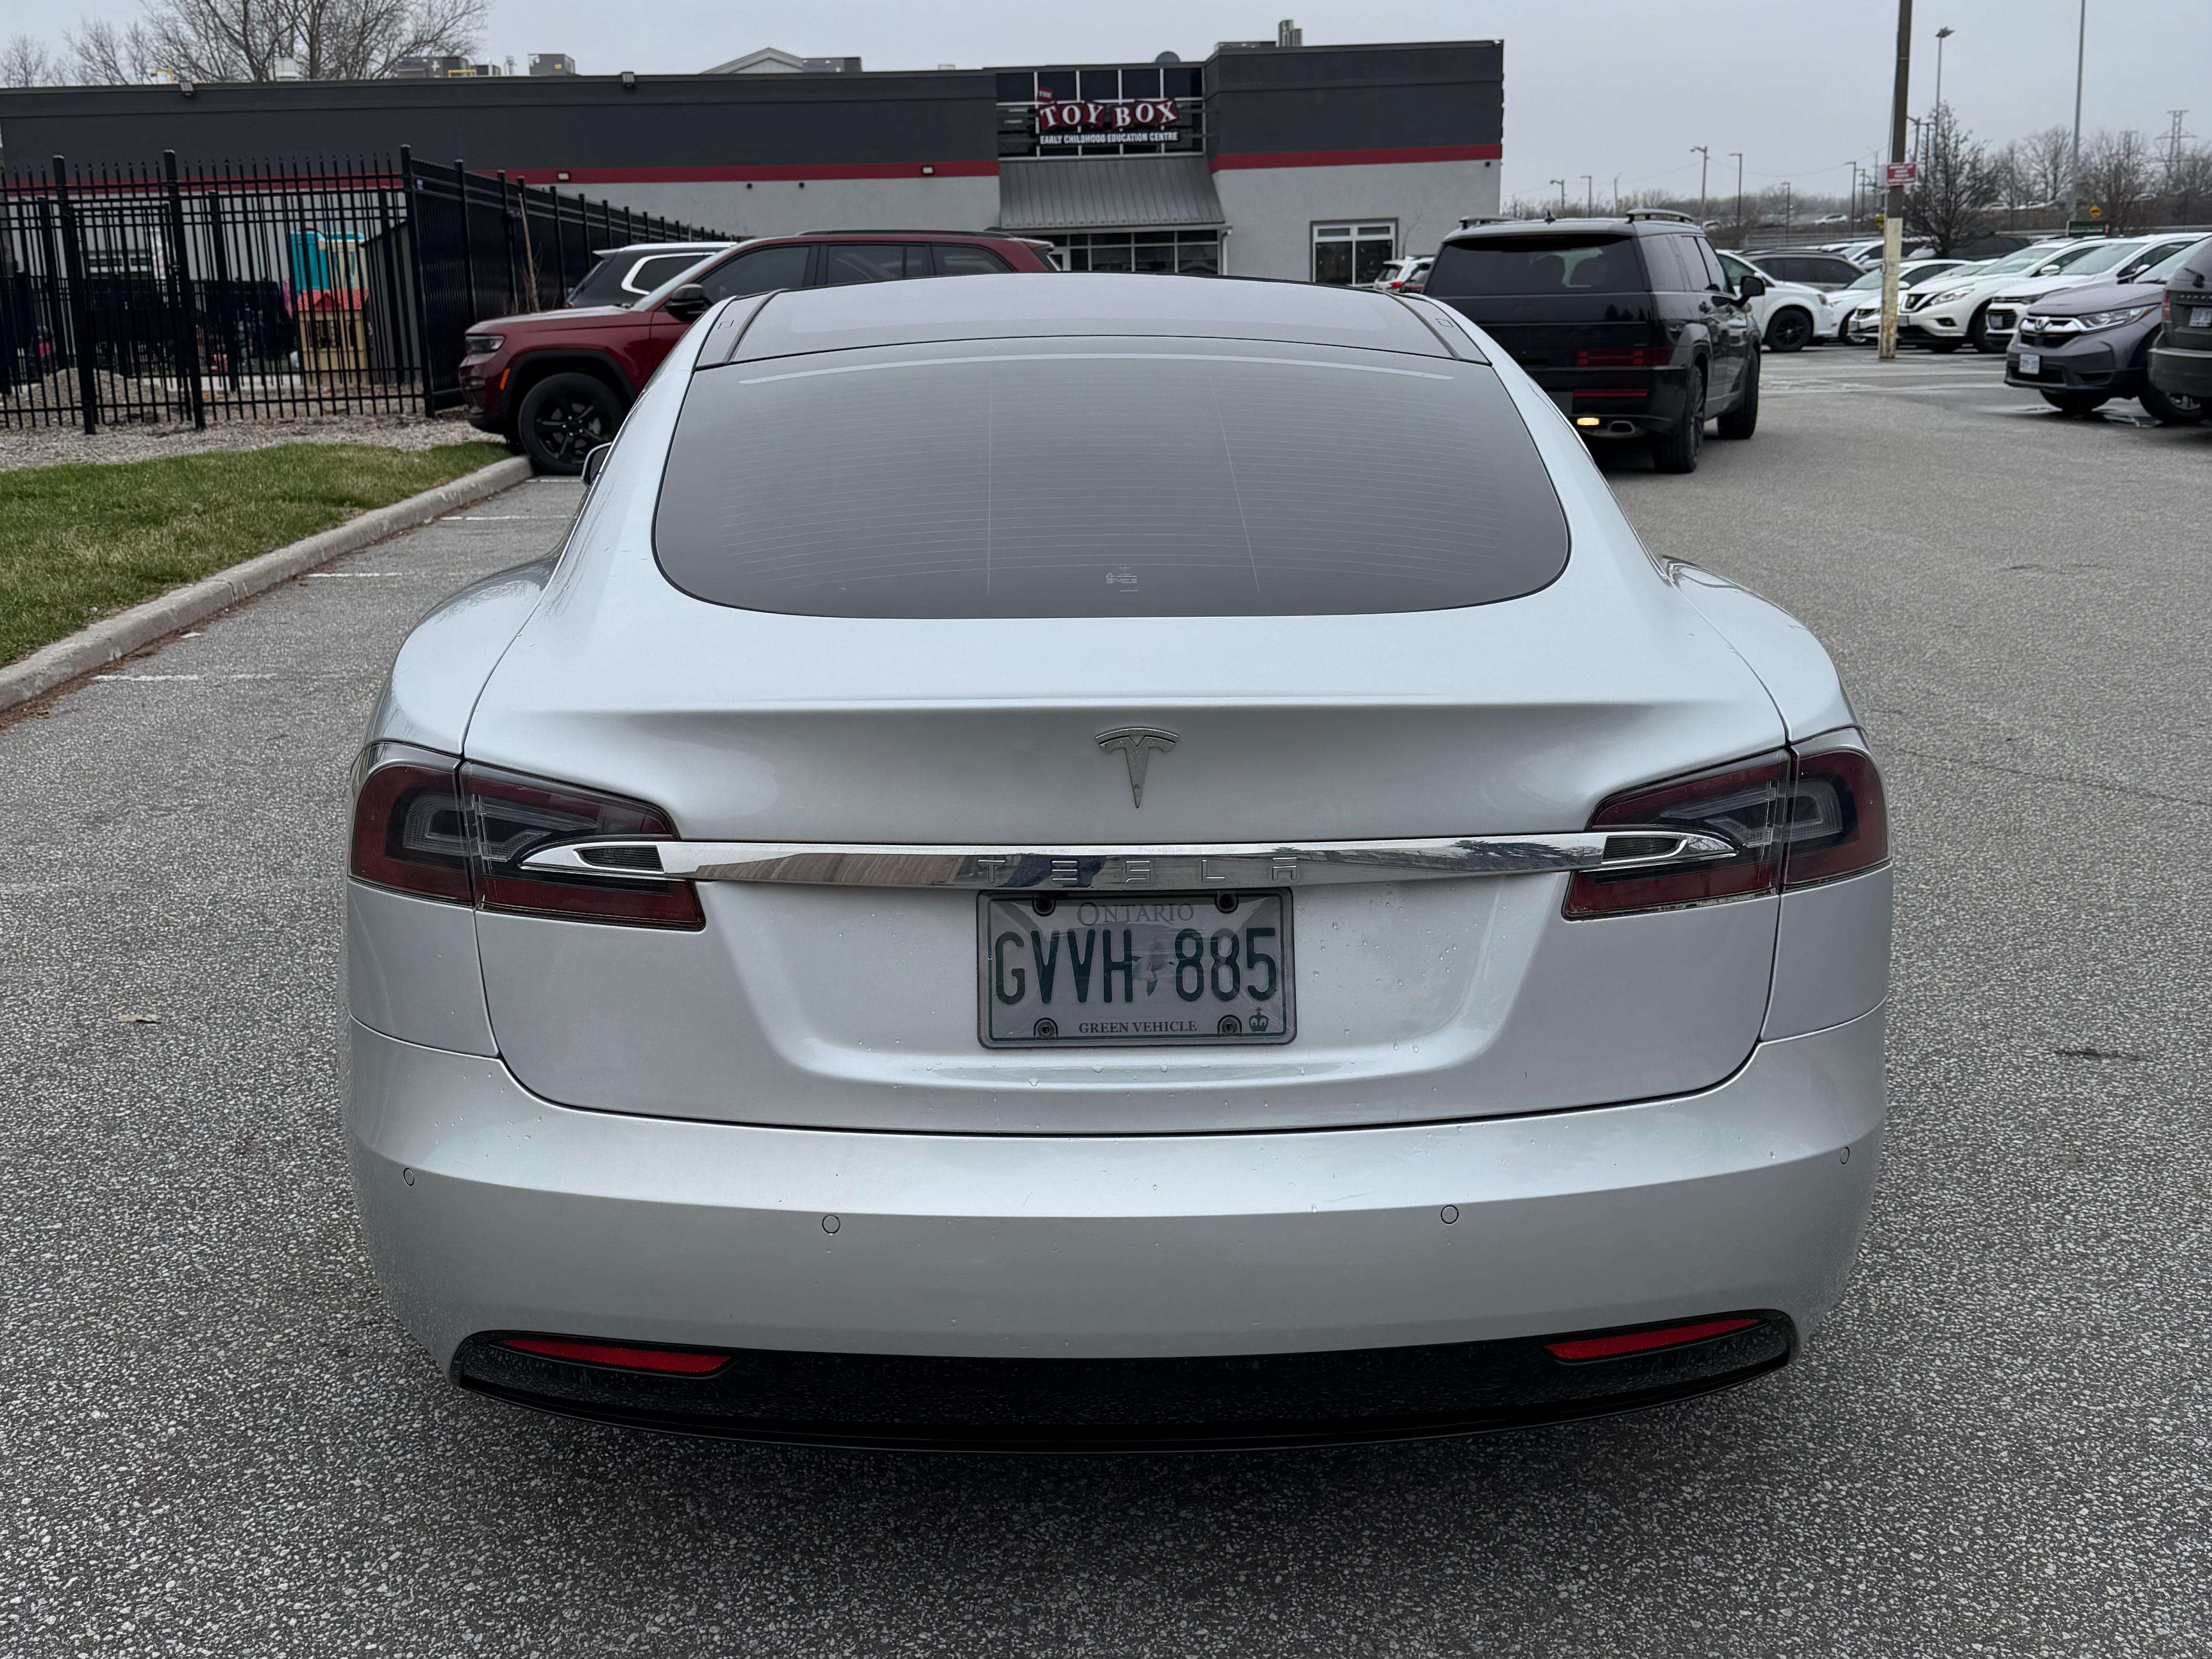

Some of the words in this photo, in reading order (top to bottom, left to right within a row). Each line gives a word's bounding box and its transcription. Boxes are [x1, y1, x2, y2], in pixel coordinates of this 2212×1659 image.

[1040, 103, 1104, 127] TOY
[1114, 101, 1177, 127] BOX
[1040, 135, 1062, 144] EARLY
[1063, 133, 1106, 144] CHILDHOOD
[1107, 132, 1148, 143] EDUCATION
[1149, 131, 1178, 141] CENTRE
[977, 856, 1298, 884] TESLA
[1077, 901, 1194, 926] ONTARIO
[995, 928, 1134, 1005] GVVH
[1175, 927, 1276, 1002] 885
[1078, 1022, 1128, 1034] GREEN
[1133, 1021, 1198, 1033] VEHICLE
